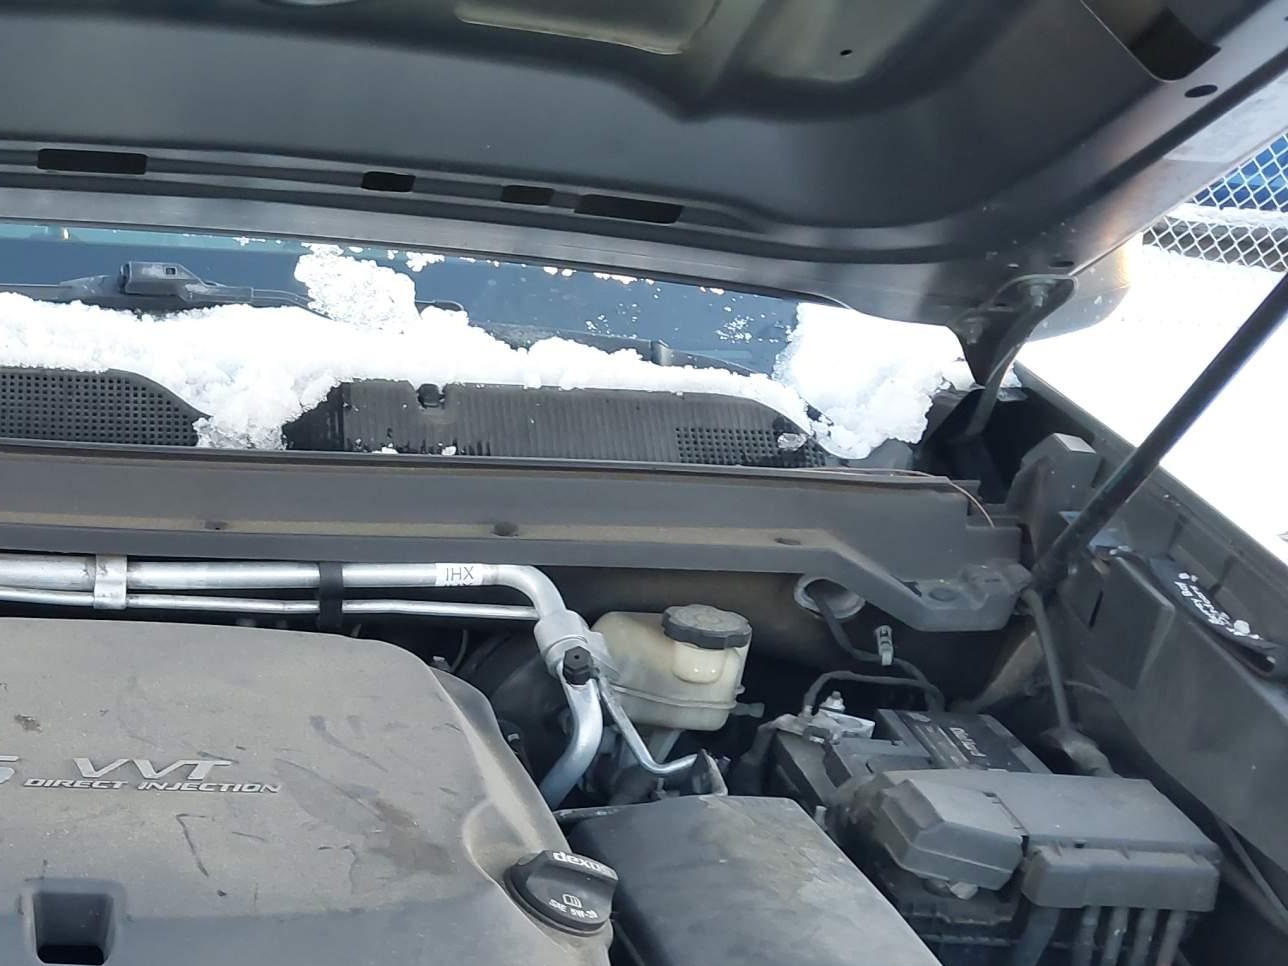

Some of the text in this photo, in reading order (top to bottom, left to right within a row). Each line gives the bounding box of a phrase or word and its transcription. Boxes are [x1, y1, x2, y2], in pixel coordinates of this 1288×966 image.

[446, 565, 474, 581] IHX
[73, 757, 235, 780] VVT
[23, 777, 282, 793] DIRECT INJECTION
